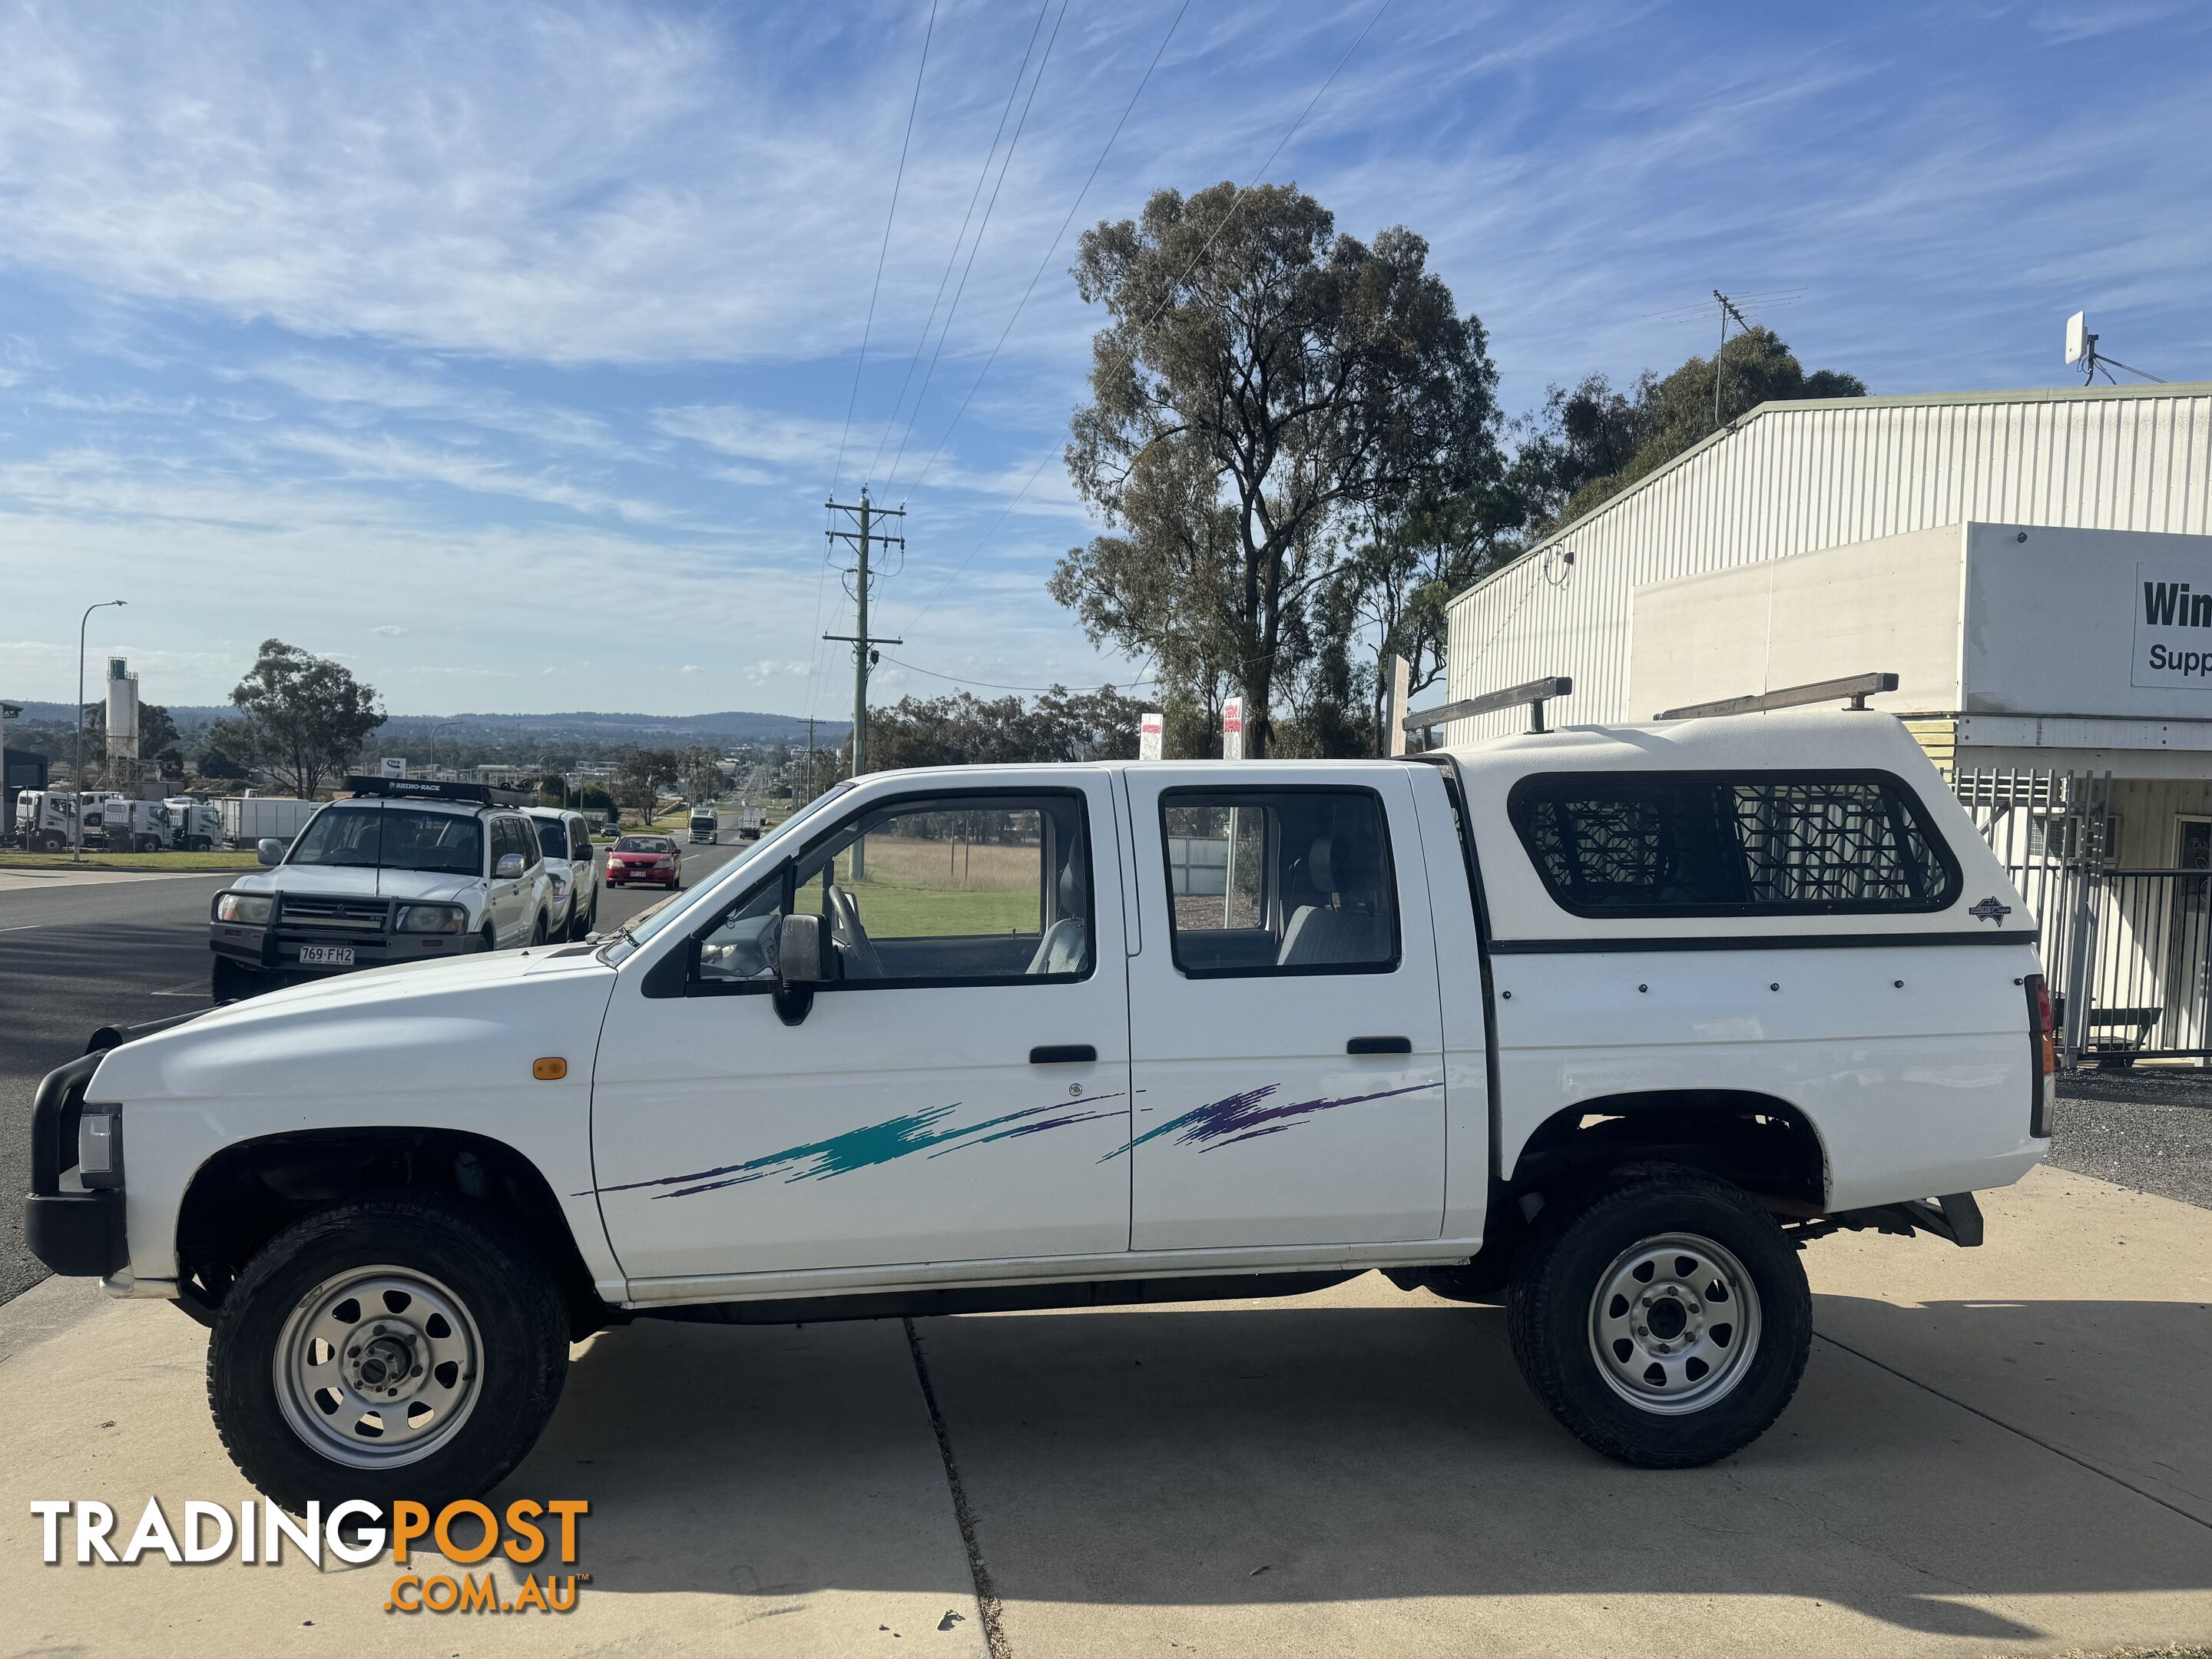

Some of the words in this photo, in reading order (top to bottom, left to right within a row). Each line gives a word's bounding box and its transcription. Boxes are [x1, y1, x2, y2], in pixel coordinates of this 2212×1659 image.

[2144, 581, 2212, 628] Win
[2149, 644, 2212, 677] Supp
[396, 783, 441, 791] RHINO-RACK
